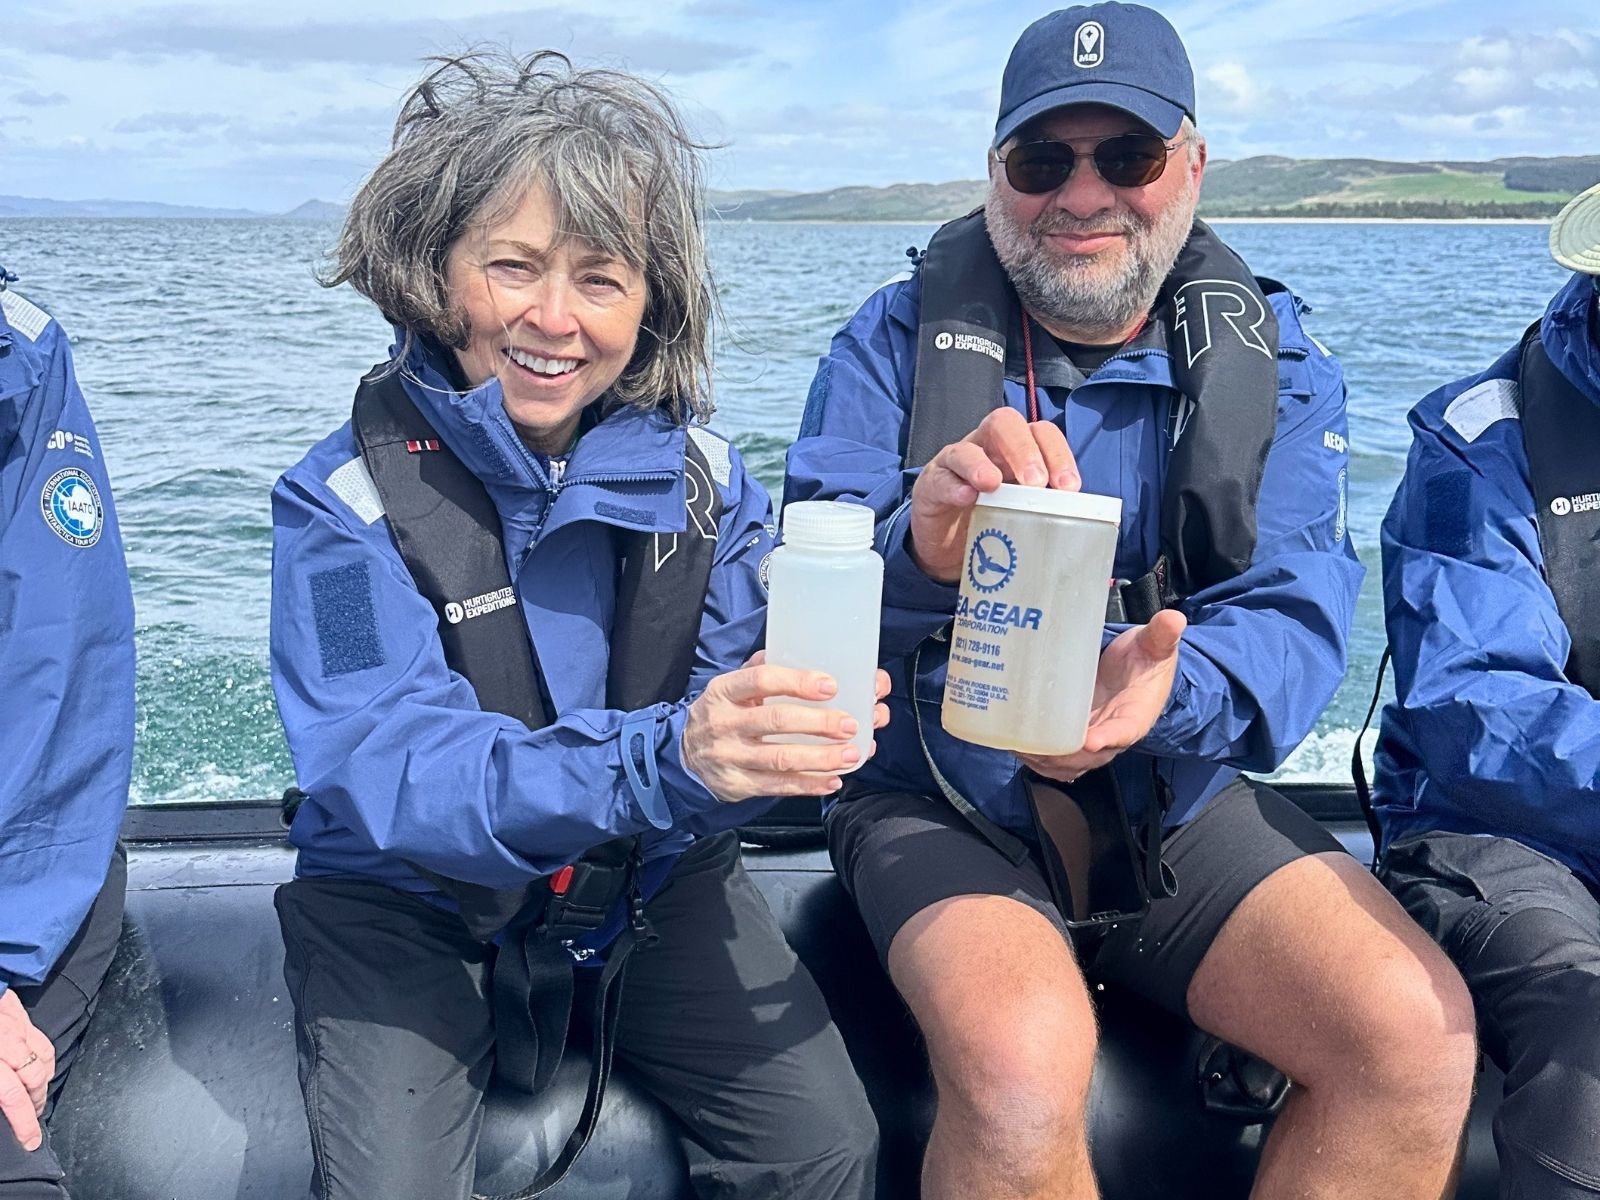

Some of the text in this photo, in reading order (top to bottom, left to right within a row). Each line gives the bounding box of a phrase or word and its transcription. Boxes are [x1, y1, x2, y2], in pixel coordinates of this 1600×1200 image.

[954, 342, 1004, 363] EXPEDITIONS
[955, 333, 1004, 355] HURTIGRUTEN
[1323, 430, 1344, 454] AECO
[43, 469, 80, 500] INTERNATIONAL
[68, 499, 93, 515] IAATO
[1571, 493, 1600, 505] HURTI
[45, 509, 77, 544] ANTARCTICA
[463, 586, 514, 610] HURTIGRUTEN
[465, 596, 516, 619] EXPEDITIONS
[956, 595, 1043, 631] EA-GEAR
[957, 617, 1008, 636] CORPORATION
[968, 640, 1000, 656] 728-9116
